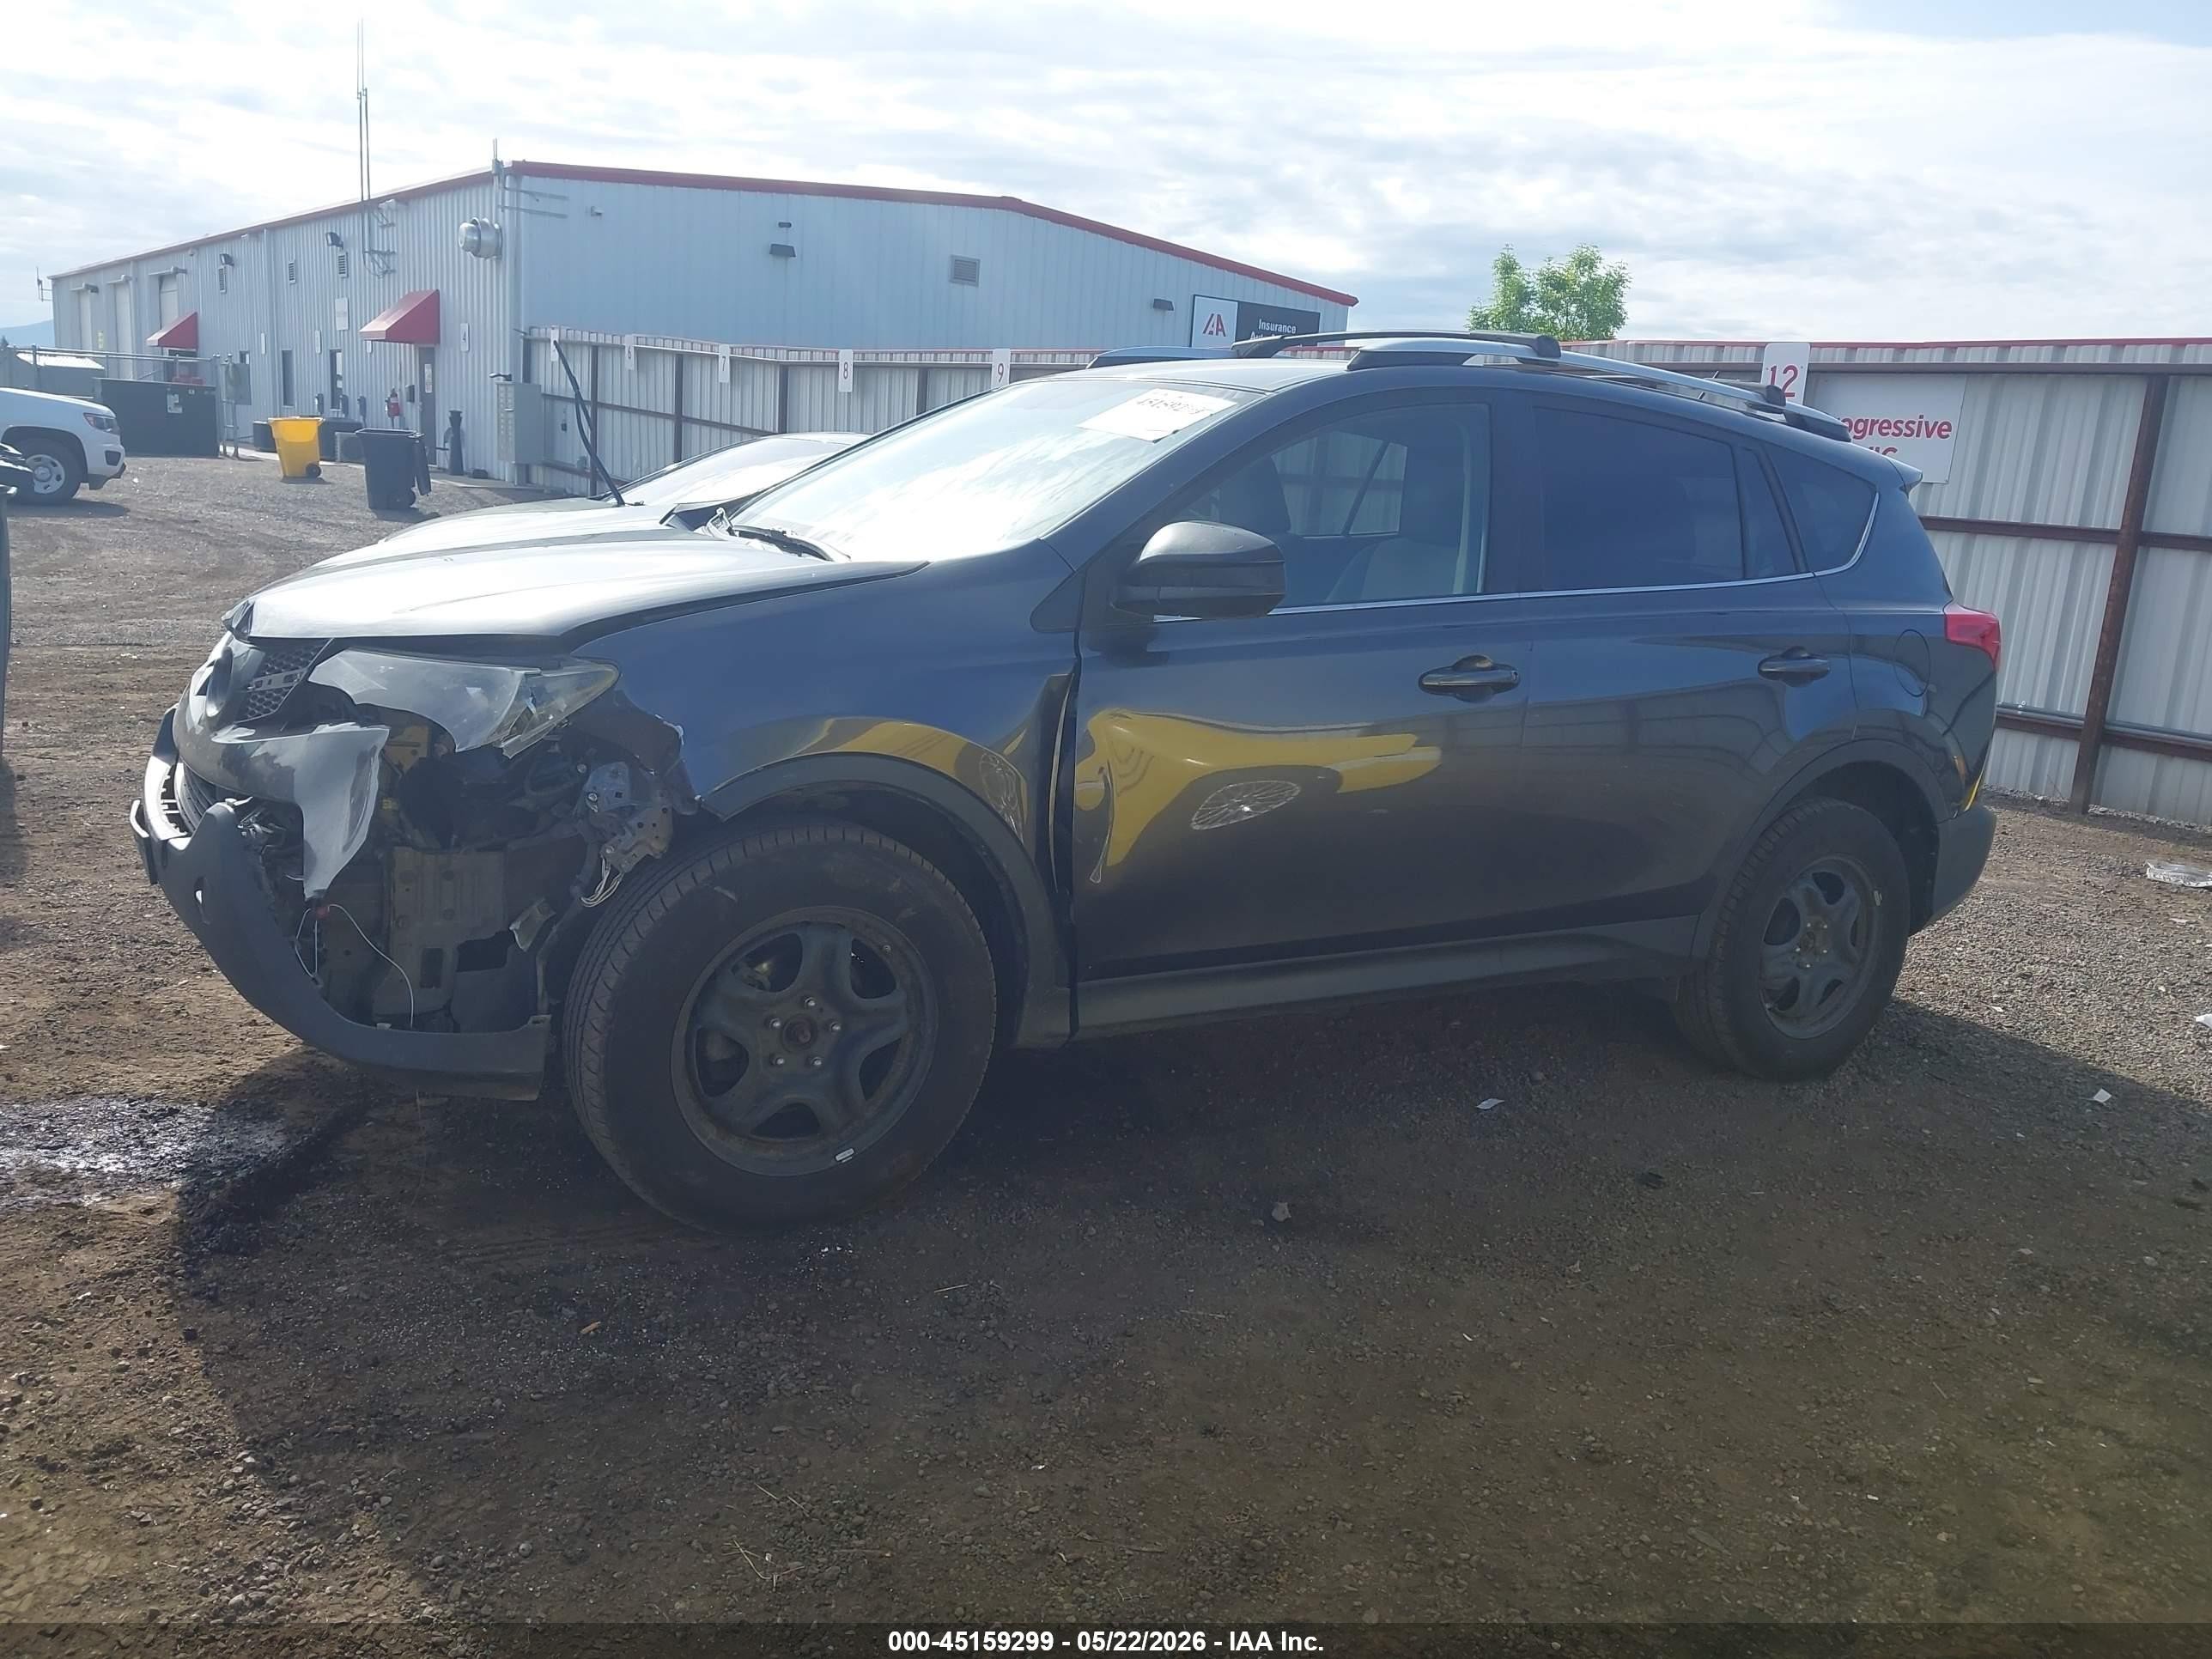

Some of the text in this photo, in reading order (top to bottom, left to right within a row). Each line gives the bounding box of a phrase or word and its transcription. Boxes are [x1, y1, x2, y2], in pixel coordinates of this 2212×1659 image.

[1258, 319, 1296, 334] Insurance
[627, 343, 632, 360] 6
[721, 355, 726, 372] 7
[843, 361, 848, 380] 8
[996, 362, 1005, 383] 9
[1769, 364, 1799, 398] 12
[1838, 414, 1953, 440] ogressive
